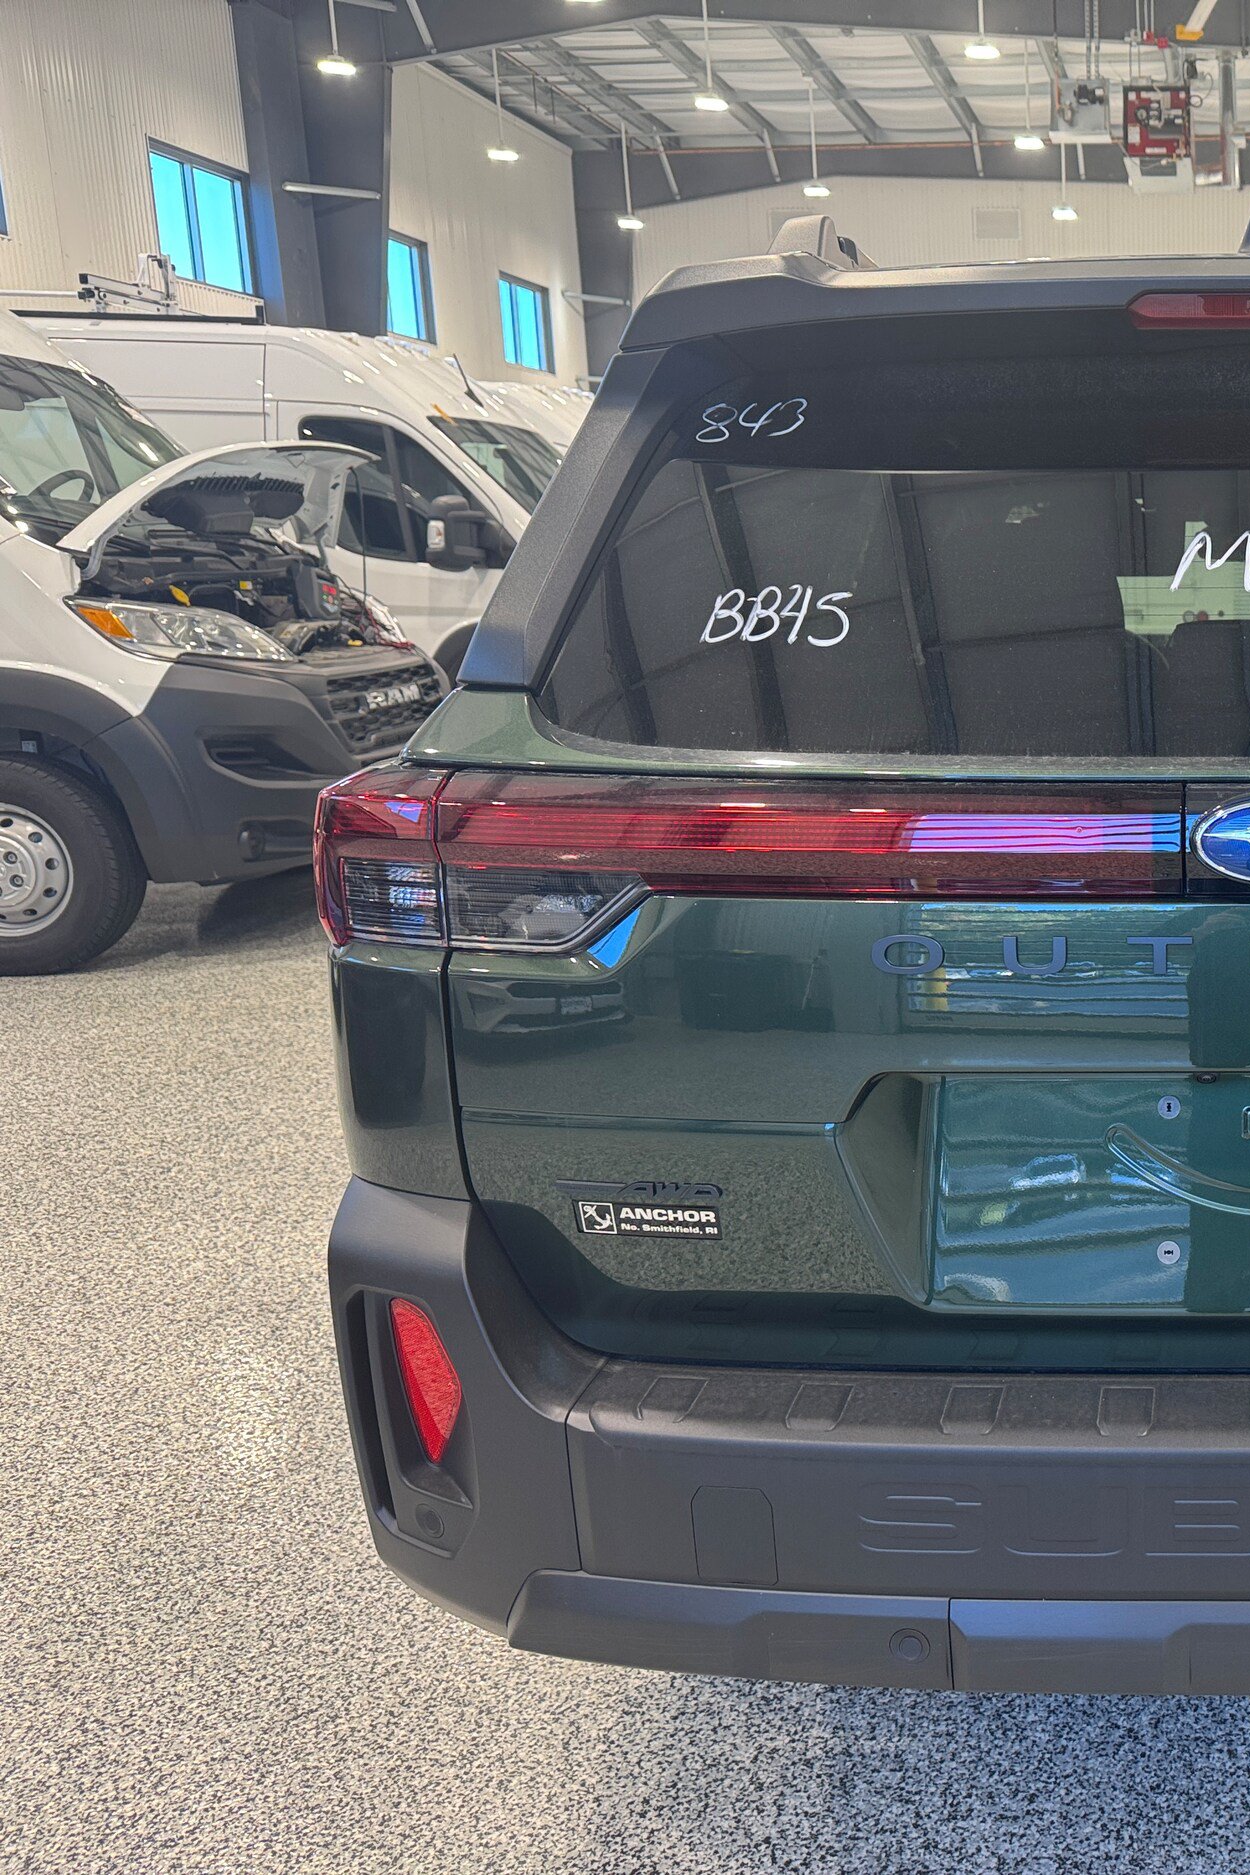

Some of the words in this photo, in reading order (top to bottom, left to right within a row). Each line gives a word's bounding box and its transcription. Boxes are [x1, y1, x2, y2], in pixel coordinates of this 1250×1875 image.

[696, 398, 808, 443] 843
[700, 583, 853, 647] BB45
[366, 684, 421, 710] RAM
[615, 1180, 724, 1200] AWD
[619, 1207, 717, 1223] ANCHOR
[620, 1222, 641, 1232] No.
[641, 1224, 703, 1235] Smithfield,
[705, 1226, 718, 1235] RI
